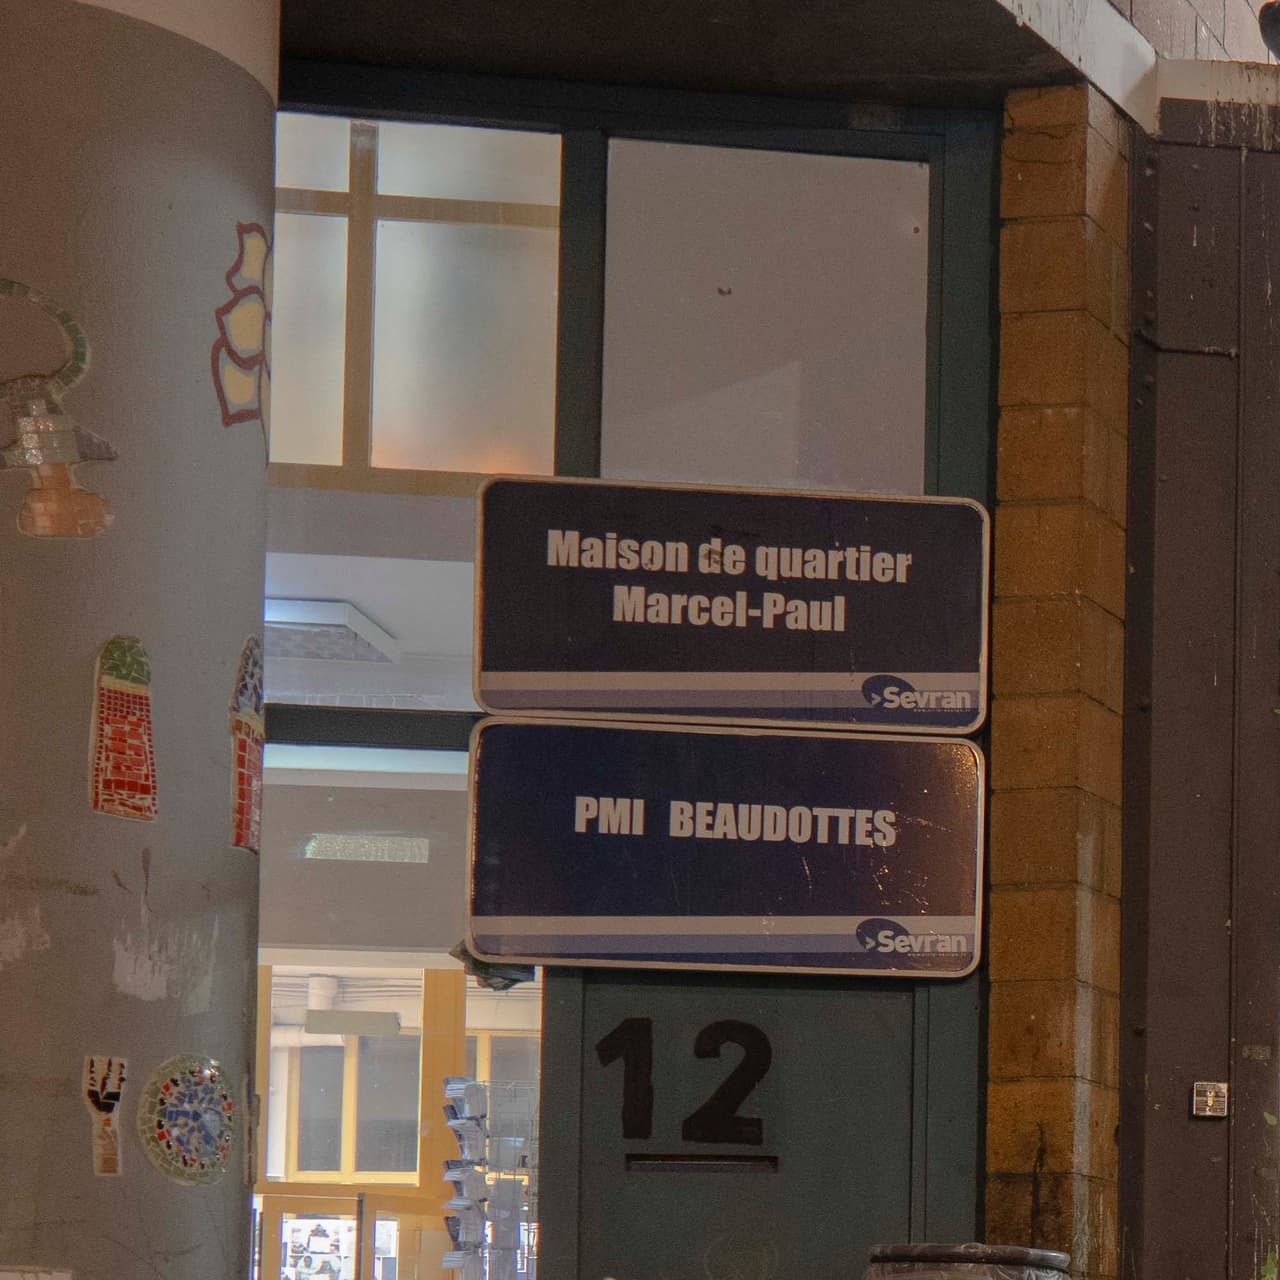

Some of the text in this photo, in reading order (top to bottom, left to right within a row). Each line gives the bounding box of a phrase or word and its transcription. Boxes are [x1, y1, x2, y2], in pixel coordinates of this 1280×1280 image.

[547, 529, 912, 584] Maison de quartier
[613, 585, 846, 632] Marcel-Paul
[883, 687, 971, 709] Sevran
[574, 797, 897, 847] PMI BEAUDOTTES
[878, 930, 967, 953] Sevran
[595, 1017, 773, 1146] 12
